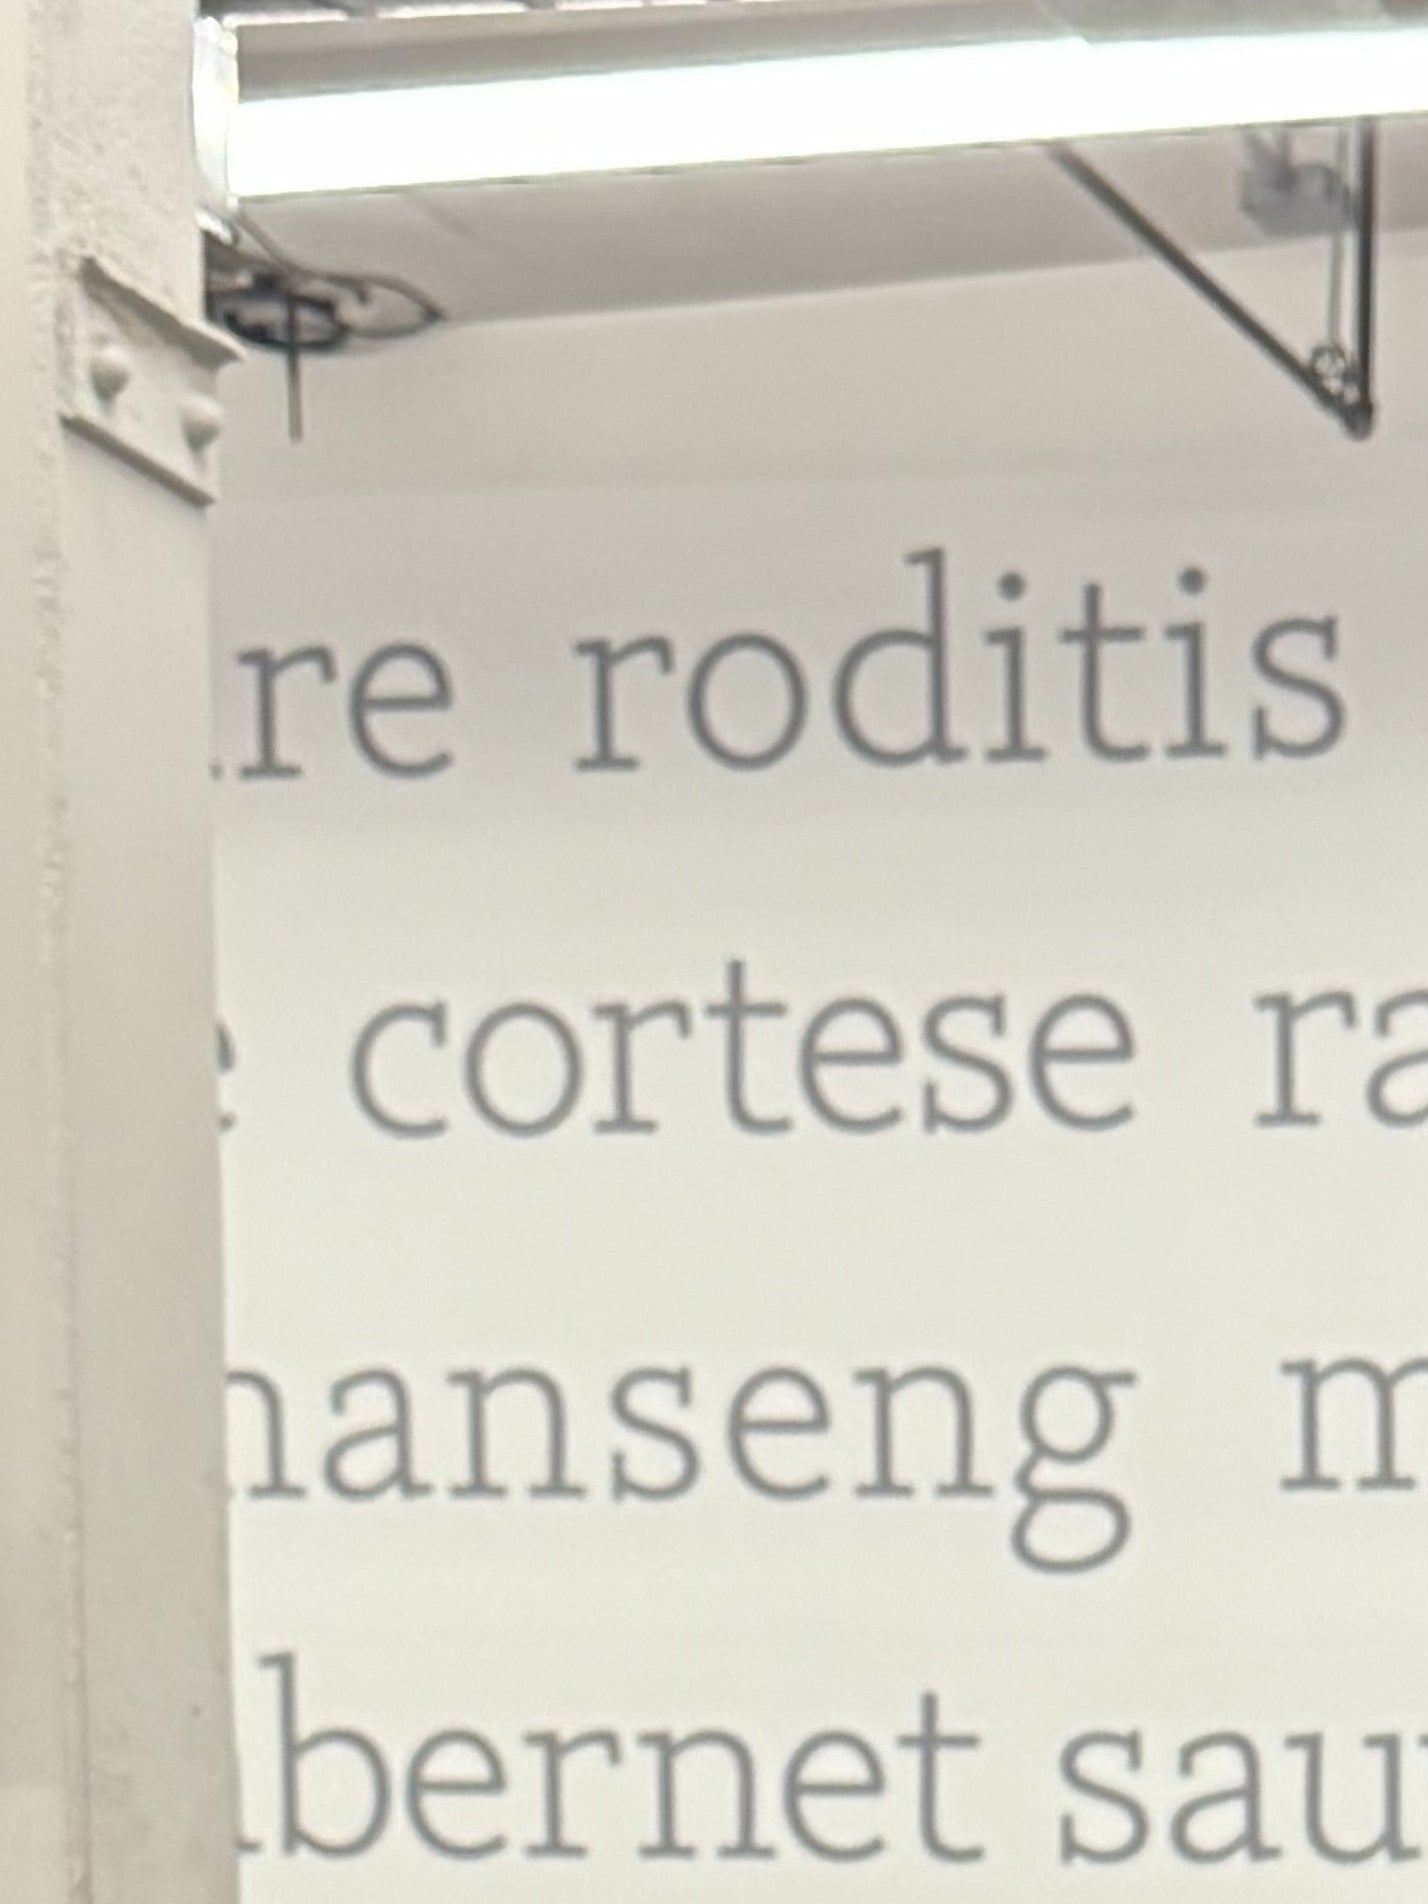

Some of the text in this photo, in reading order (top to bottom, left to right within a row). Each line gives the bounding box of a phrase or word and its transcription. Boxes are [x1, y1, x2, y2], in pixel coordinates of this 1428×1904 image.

[208, 642, 454, 781] re
[573, 546, 1346, 772] roditis
[349, 959, 1136, 1140] cortese
[238, 1650, 985, 1864] bernet
